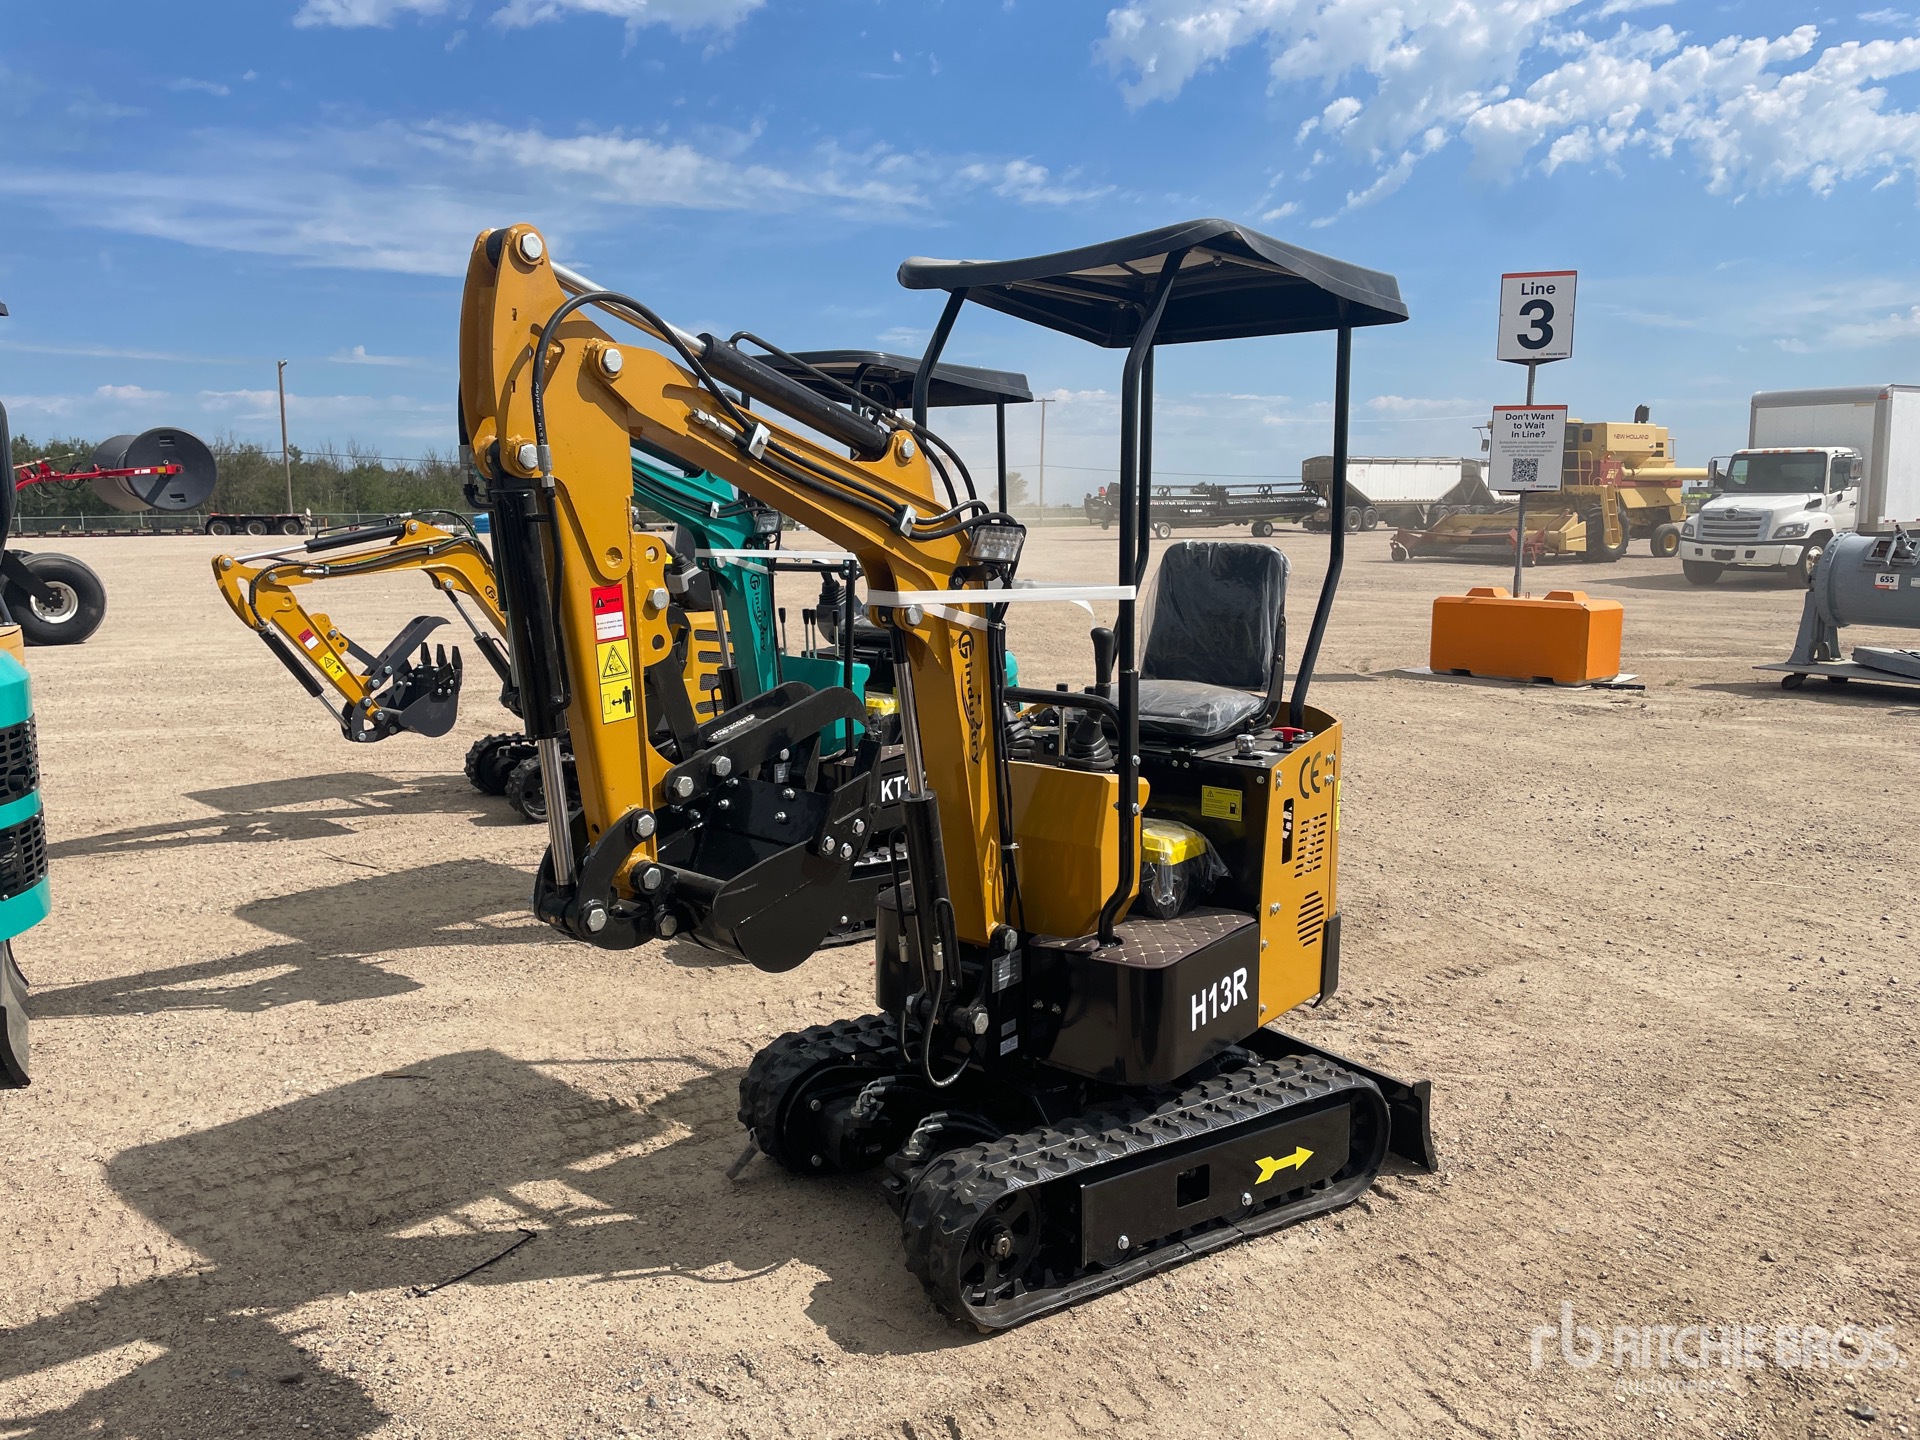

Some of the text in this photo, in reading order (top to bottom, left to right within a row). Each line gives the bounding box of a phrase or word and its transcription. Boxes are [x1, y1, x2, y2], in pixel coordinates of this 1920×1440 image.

[1521, 281, 1556, 296] Line
[1516, 298, 1555, 350] 3
[1522, 430, 1546, 438] Line?
[1880, 575, 1895, 583] 655
[1190, 966, 1249, 1032] H13R
